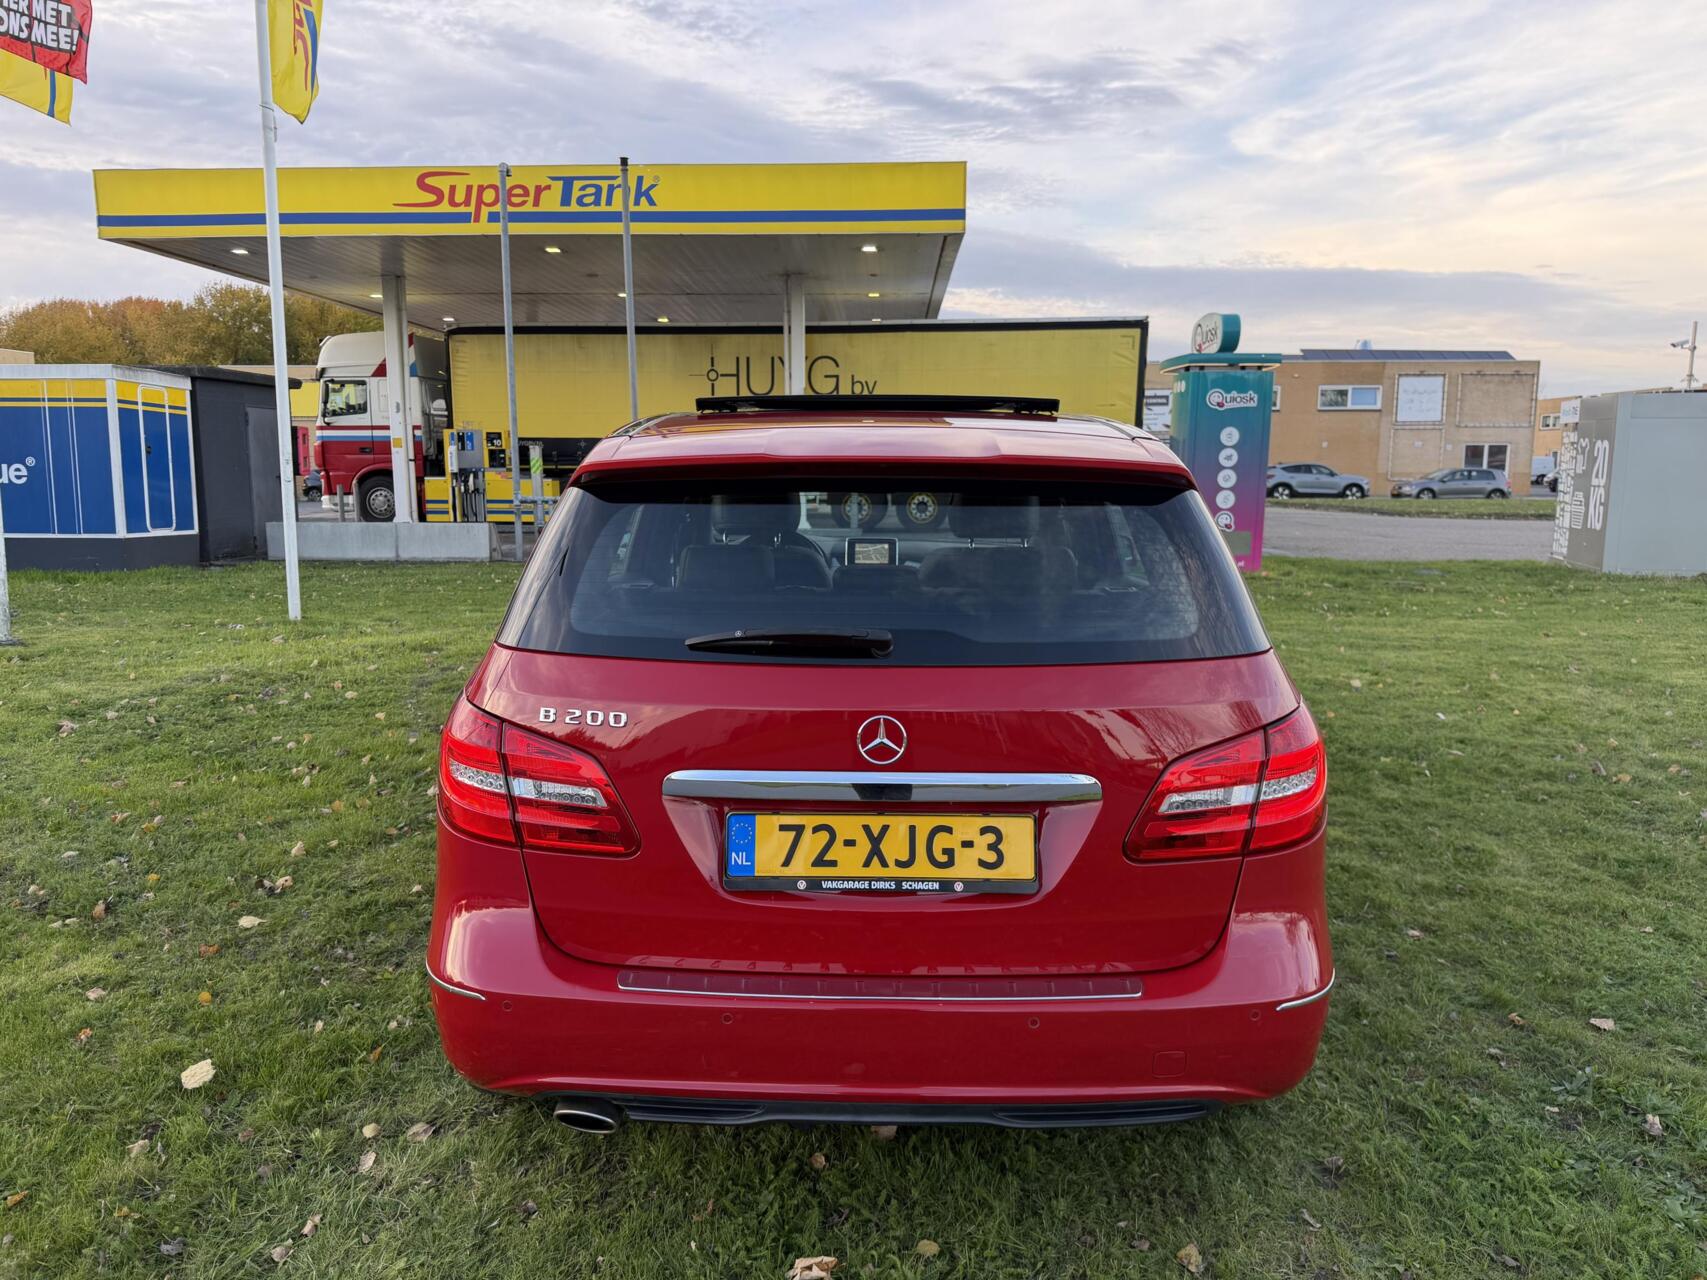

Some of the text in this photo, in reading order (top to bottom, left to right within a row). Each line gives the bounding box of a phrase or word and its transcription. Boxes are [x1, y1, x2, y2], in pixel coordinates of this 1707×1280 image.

[32, 0, 72, 27] MET
[0, 7, 79, 52] ONS MEE!
[706, 355, 877, 396] HUG bv
[1208, 390, 1256, 408] Quiosk
[539, 707, 628, 727] B 200
[778, 823, 1005, 871] 72-XJG-3
[731, 852, 752, 866] NL
[821, 880, 869, 889] VAKGARAGE
[871, 881, 896, 890] DIRKS
[901, 881, 940, 890] SCHAGEN
